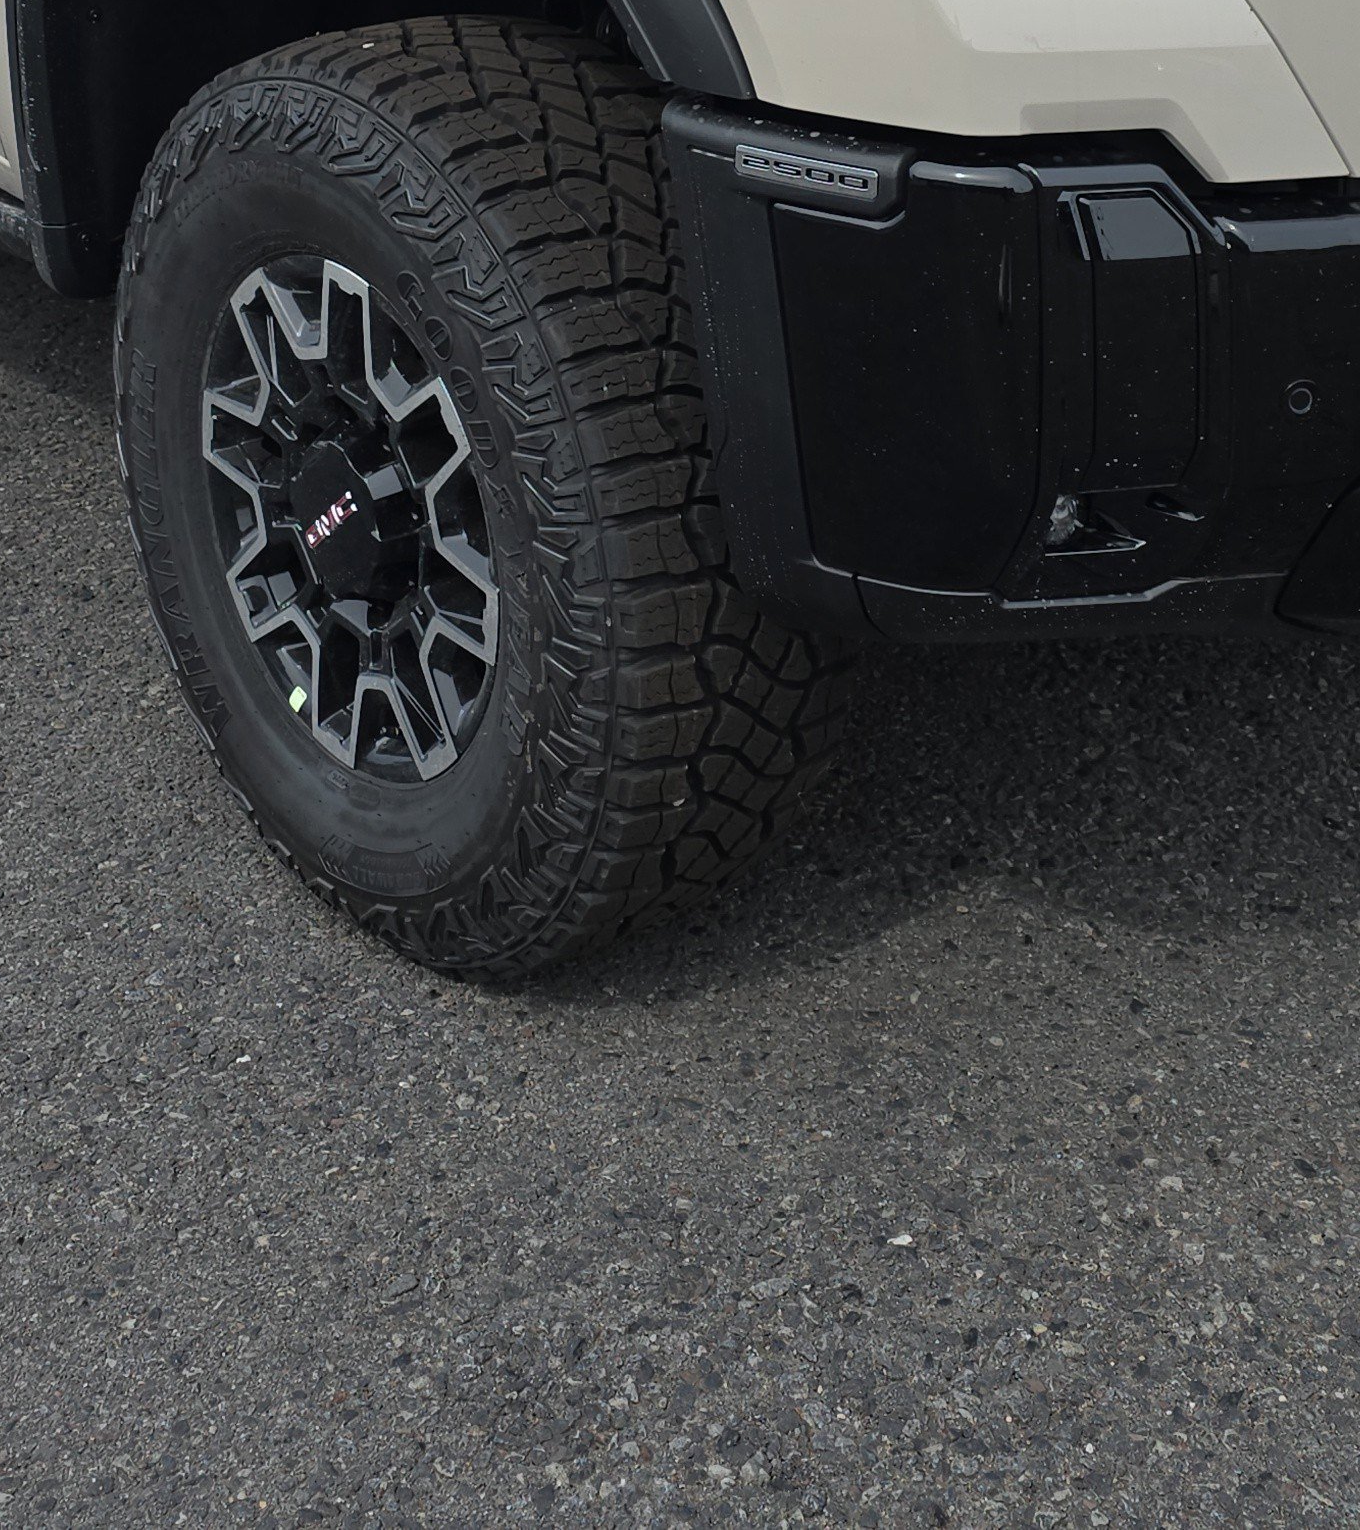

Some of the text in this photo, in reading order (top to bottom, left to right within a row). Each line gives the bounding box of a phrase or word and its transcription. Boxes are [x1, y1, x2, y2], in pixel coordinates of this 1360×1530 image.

[741, 154, 869, 192] 2500
[129, 348, 232, 738] WRANGLER
[305, 490, 359, 549] GMC
